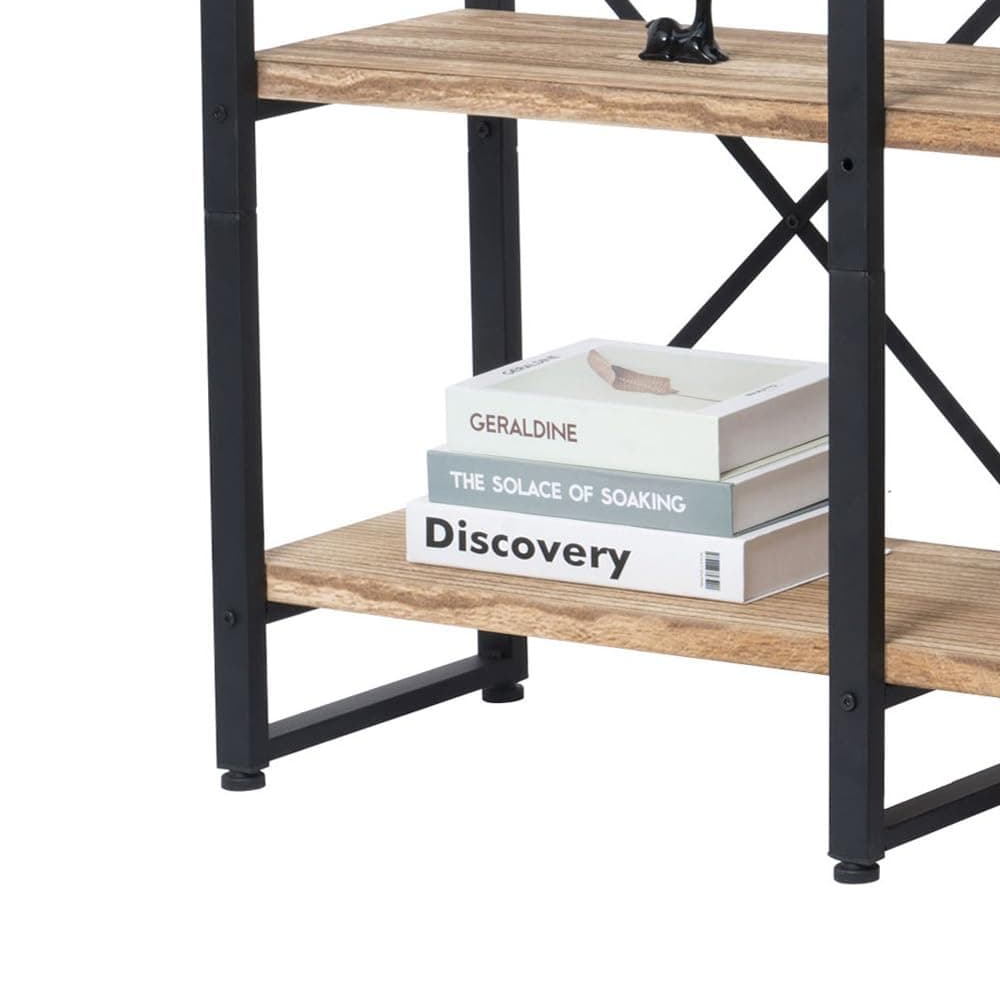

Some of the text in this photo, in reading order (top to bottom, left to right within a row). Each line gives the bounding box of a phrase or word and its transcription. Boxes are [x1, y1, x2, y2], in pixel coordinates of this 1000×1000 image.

[469, 412, 578, 443] GERALDINE
[450, 471, 687, 513] THE SOLACE OF SOAKING
[425, 516, 631, 579] Discovery
